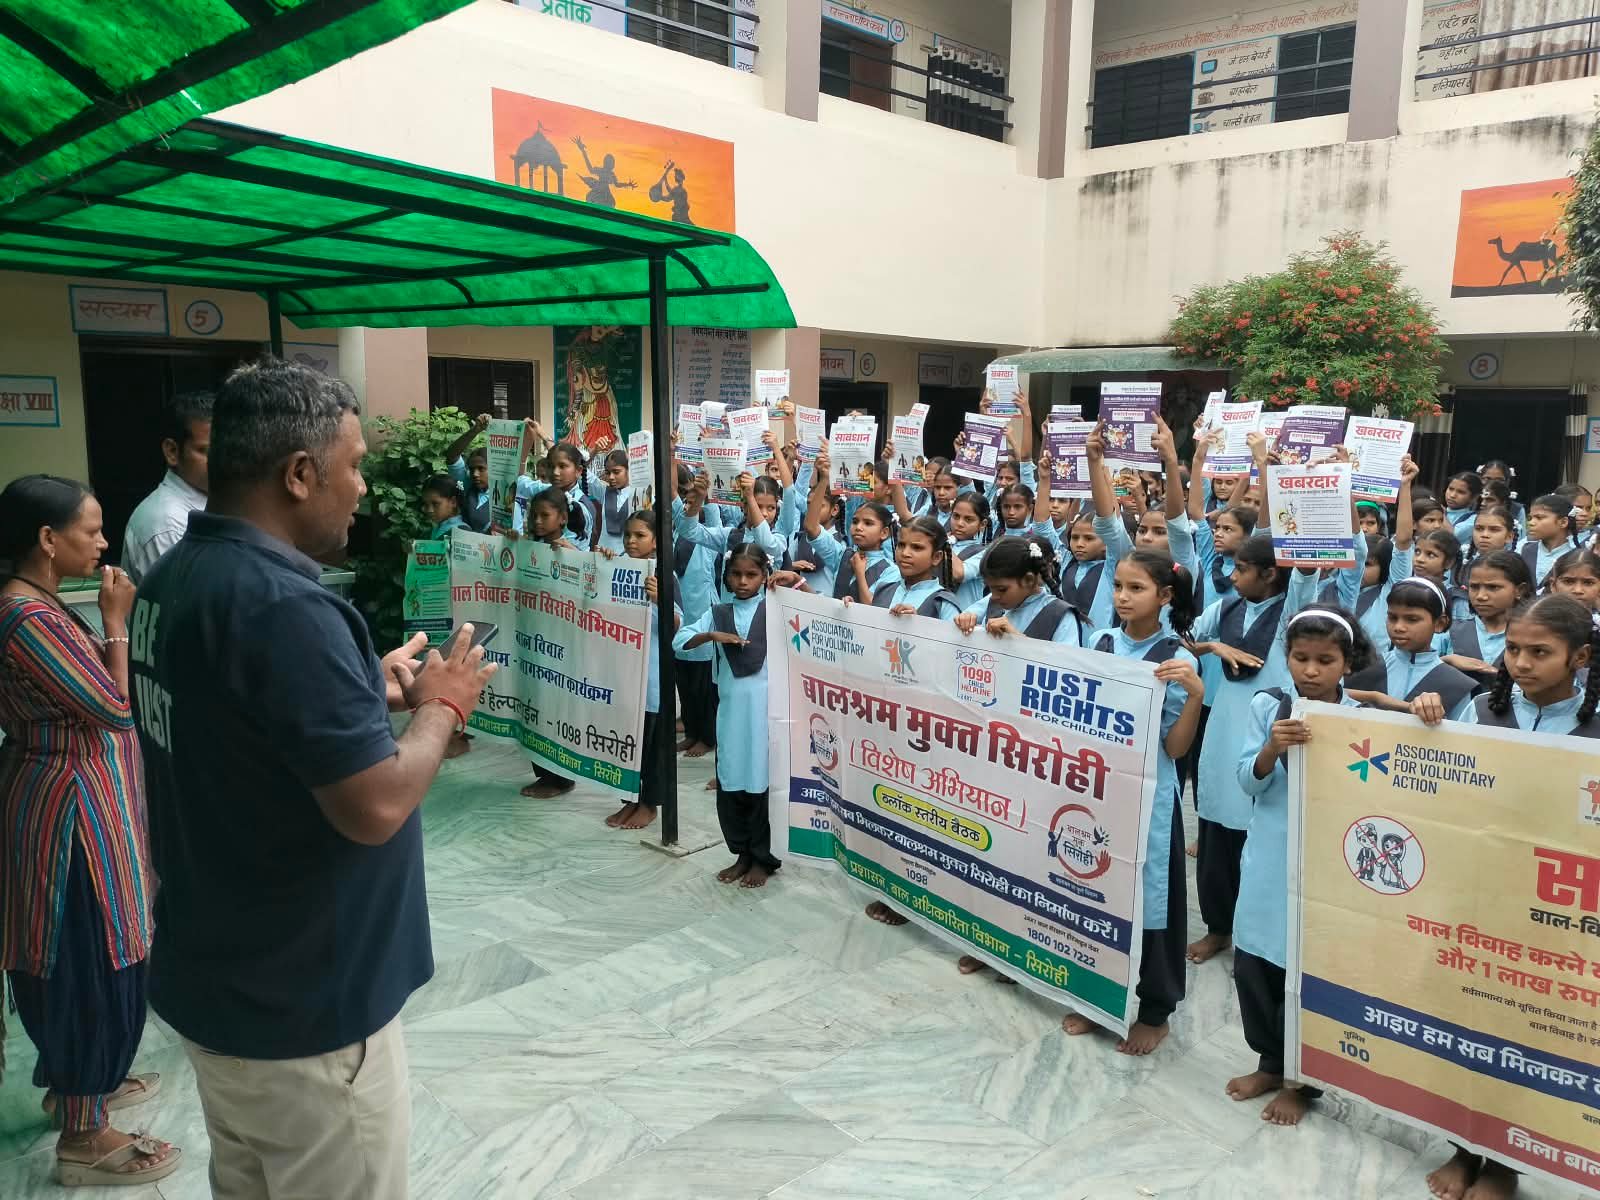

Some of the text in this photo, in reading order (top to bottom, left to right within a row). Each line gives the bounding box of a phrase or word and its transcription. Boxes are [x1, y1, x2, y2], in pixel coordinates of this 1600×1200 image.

[193, 310, 208, 327] 5
[1476, 359, 1489, 374] 8
[22, 392, 54, 411] VIII
[489, 434, 520, 449] सावधान
[835, 433, 870, 443] सावधान
[1355, 425, 1404, 441] खबरदार
[706, 447, 741, 457] सावधान
[1277, 475, 1340, 489] खबरदार
[612, 567, 642, 585] JUST
[612, 582, 645, 601] RIGHT
[475, 581, 511, 604] विवाह
[540, 589, 576, 625] सिरोही
[577, 606, 645, 651] अभियान
[812, 619, 854, 641] ASSOCIATION
[534, 634, 565, 661] विवाह
[812, 632, 865, 657] FOR VOLUNTARY
[812, 646, 836, 663] ACTION
[961, 665, 992, 684] 1098
[1022, 664, 1102, 702] JUST
[566, 676, 614, 705] कार्यक्रम
[961, 684, 992, 697] HELPLINE
[1021, 685, 1135, 736] RIGHTS
[801, 673, 1111, 801] बालश्रम मुक्त सिरोही
[1034, 712, 1124, 744] FOR CHILDREN
[556, 719, 581, 745] 1098
[586, 724, 637, 763] सिरोही
[1395, 743, 1476, 769] ASSOCIATION
[594, 760, 622, 785] सिरोही
[1392, 774, 1438, 795] ACTION
[1393, 759, 1496, 789] FOR VOLUNTARY
[881, 792, 981, 843] ब्लॉक स्तरीय बैठक
[1063, 840, 1095, 866] सिरोही
[855, 811, 894, 841] मिलकर
[894, 832, 938, 860] बालश्रम
[940, 851, 969, 876] मुक्त
[970, 862, 1009, 896] सिरोही
[1012, 884, 1033, 905] का
[1034, 890, 1081, 926] निर्माण
[905, 867, 928, 886] 1098
[890, 881, 910, 902] बाल
[912, 895, 970, 937] अधिकारिता
[971, 921, 1011, 957] विभाग
[1026, 950, 1070, 987] सिरोही
[1406, 914, 1451, 940] बाल
[1457, 923, 1523, 962] विवाह
[1527, 946, 1587, 977] करने
[1027, 927, 1051, 946] 1800
[1053, 940, 1071, 956] 102
[1073, 948, 1096, 968] 7222
[1436, 947, 1600, 1008] और 1 लाख रुप
[1461, 984, 1598, 1031] सर्वसामान्य को सूचित किया जाता है
[1529, 1020, 1547, 1032] बाल
[1549, 1025, 1576, 1040] विवाह
[1339, 1040, 1370, 1063] 100
[1363, 1005, 1589, 1091] आइए हम सब मिलकर
[1507, 1126, 1560, 1162] जिला
